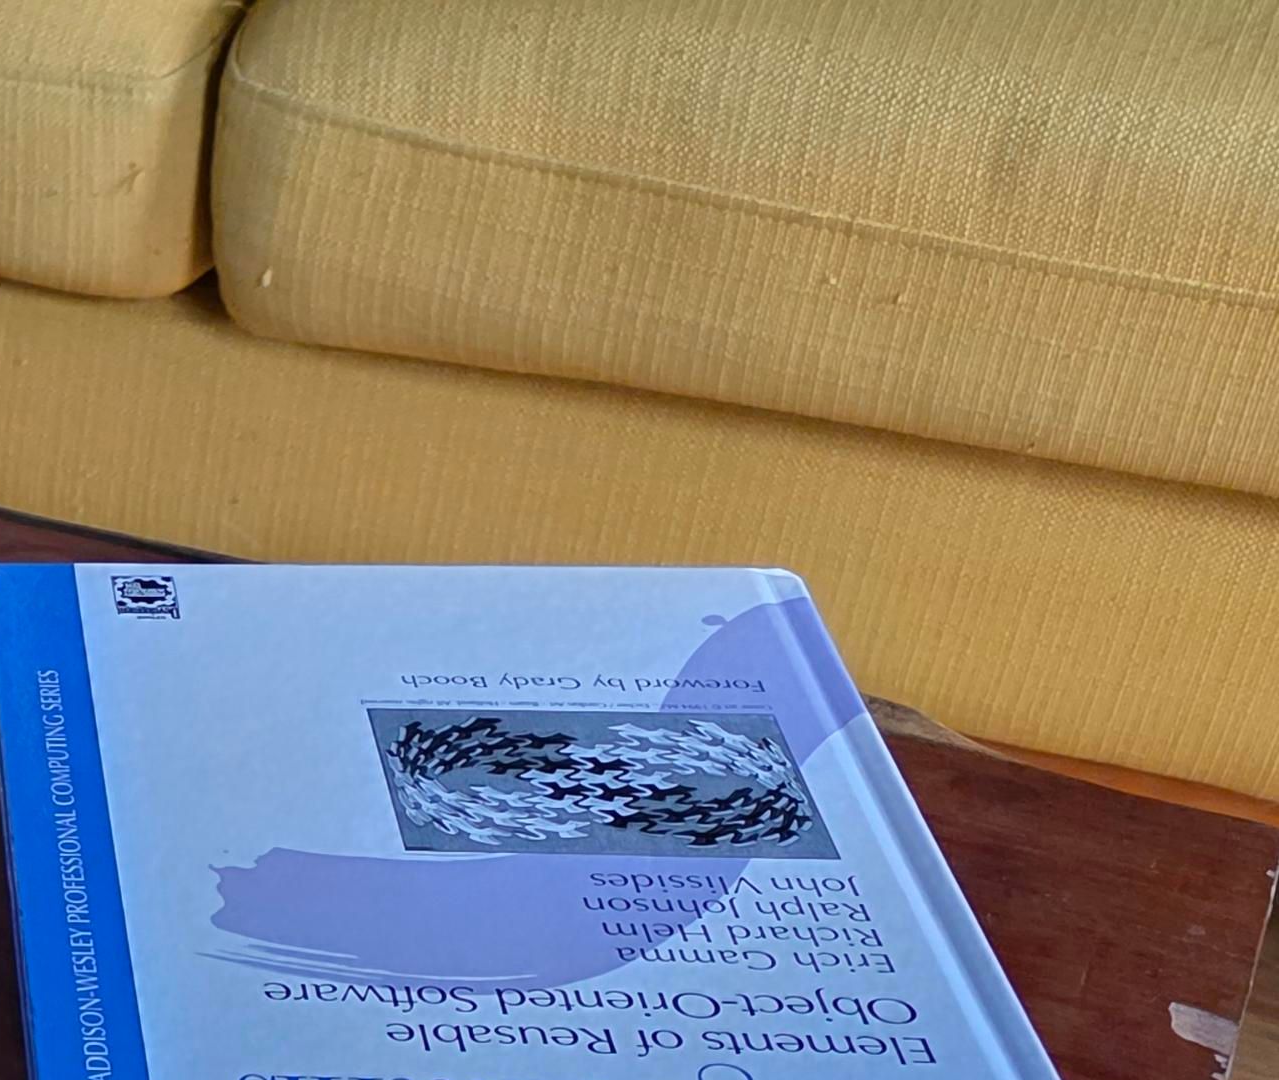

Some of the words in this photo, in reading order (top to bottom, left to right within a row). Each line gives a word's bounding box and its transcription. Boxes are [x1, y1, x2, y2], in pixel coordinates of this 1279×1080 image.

[36, 668, 61, 712] SERIES
[400, 674, 488, 689] Booch
[498, 672, 580, 690] Grady
[592, 673, 626, 692] by
[633, 678, 766, 693] Foreword
[42, 713, 75, 806] COMPUTING
[54, 809, 91, 924] PROFESSIONAL
[588, 872, 763, 896] Vlissides
[769, 874, 861, 898] John
[581, 896, 741, 920] Johnson
[754, 894, 871, 922] Ralph
[601, 921, 713, 944] Helm
[726, 924, 884, 948] Richard
[615, 947, 777, 971] Gamma
[792, 951, 896, 974] Erich
[262, 982, 479, 1014] Software
[494, 988, 917, 1025] Object-Oriented
[385, 1022, 618, 1056] Reusable
[636, 1029, 684, 1057] of
[701, 1031, 937, 1066] Elements
